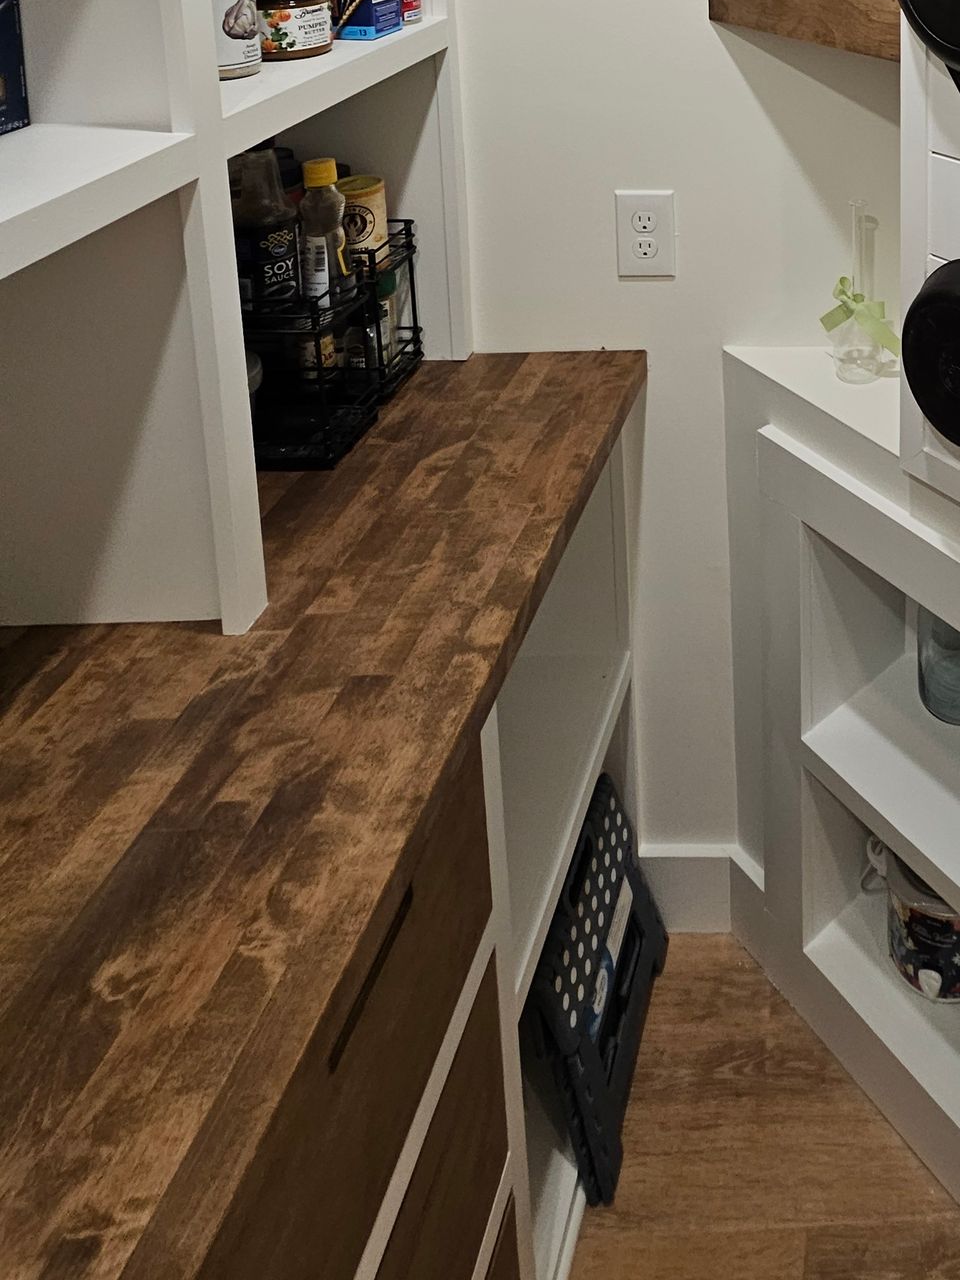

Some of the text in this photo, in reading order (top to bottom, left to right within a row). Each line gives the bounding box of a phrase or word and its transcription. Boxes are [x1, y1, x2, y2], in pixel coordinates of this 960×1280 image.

[298, 20, 328, 31] PUMPKIN
[304, 27, 325, 35] BUTTER
[263, 257, 294, 277] SOY
[264, 271, 295, 285] SAUCE
